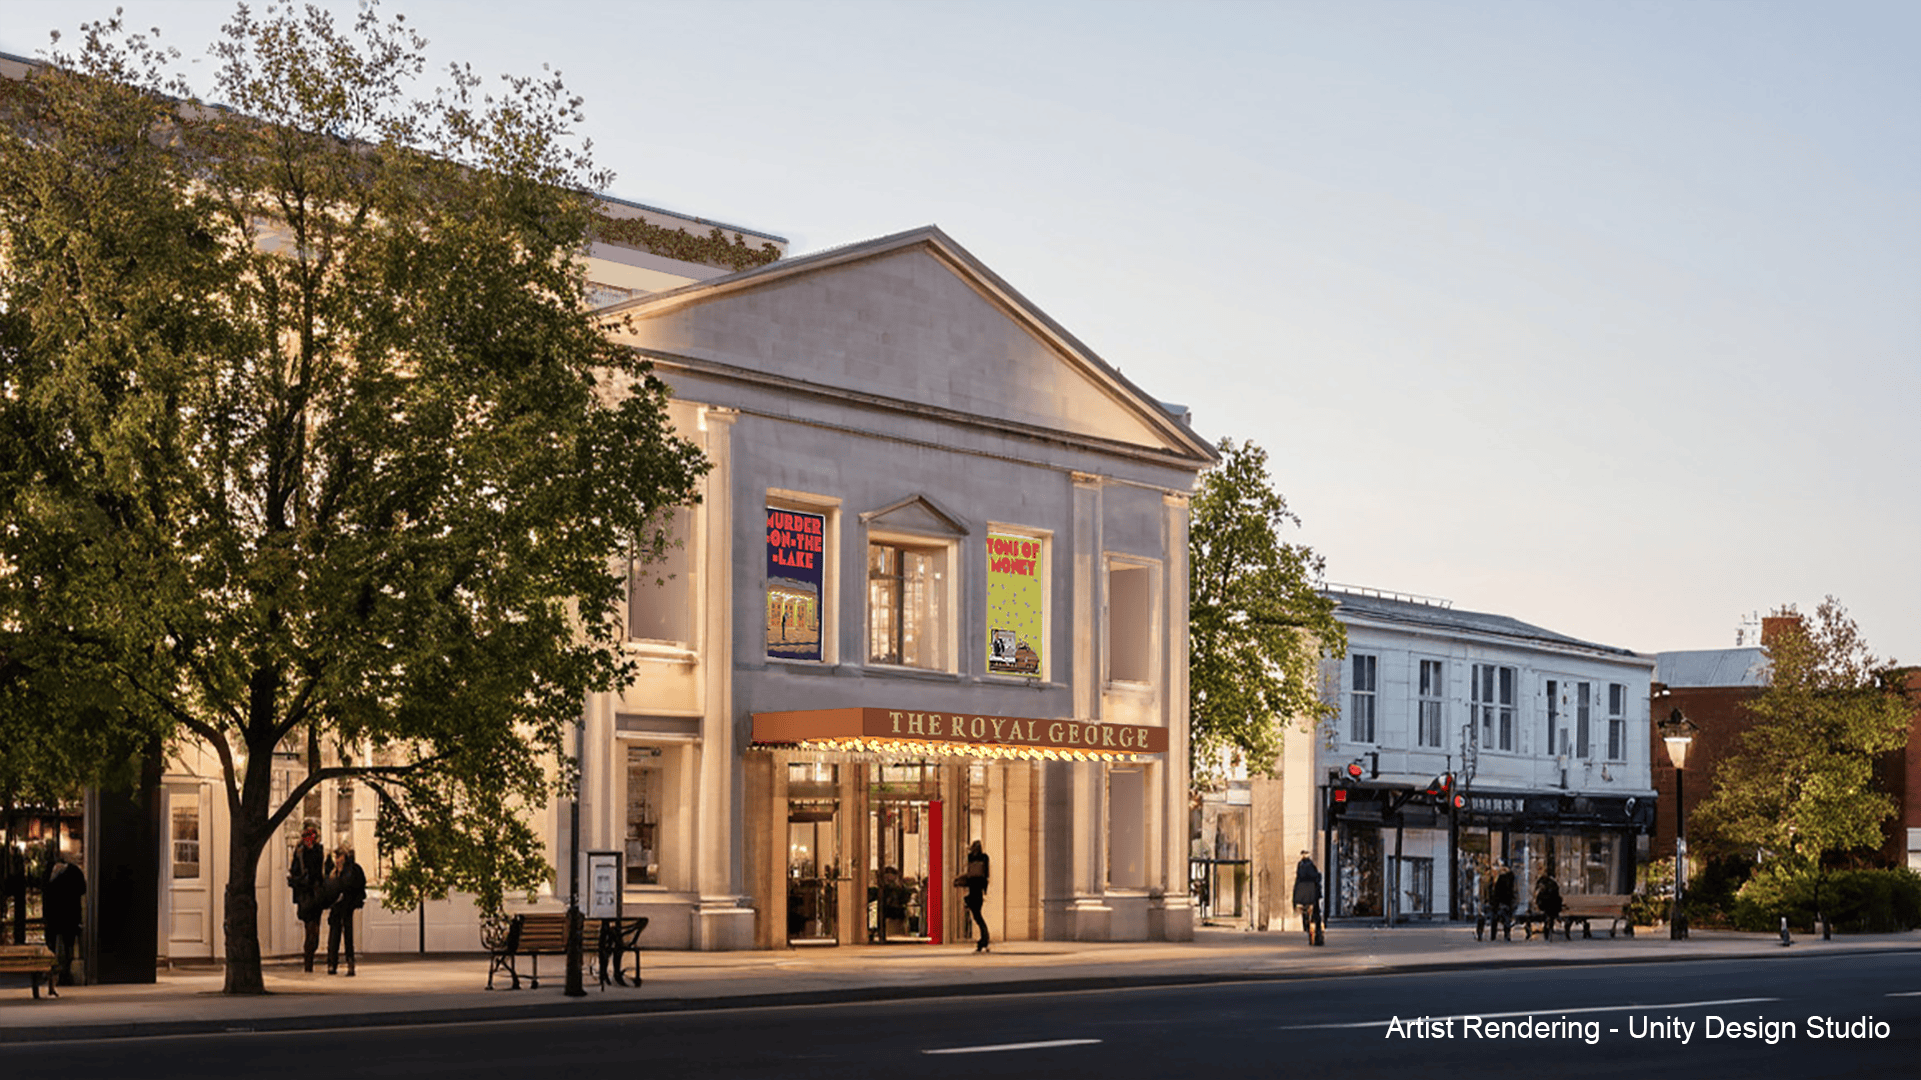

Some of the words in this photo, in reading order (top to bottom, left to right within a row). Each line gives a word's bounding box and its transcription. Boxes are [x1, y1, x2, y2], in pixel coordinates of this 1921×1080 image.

[987, 538, 1019, 557] TONS
[1022, 542, 1040, 559] OF
[991, 557, 1036, 576] MONEY
[889, 711, 943, 736] THE
[951, 716, 1041, 741] ROYAL
[1048, 722, 1149, 748] GEORGE
